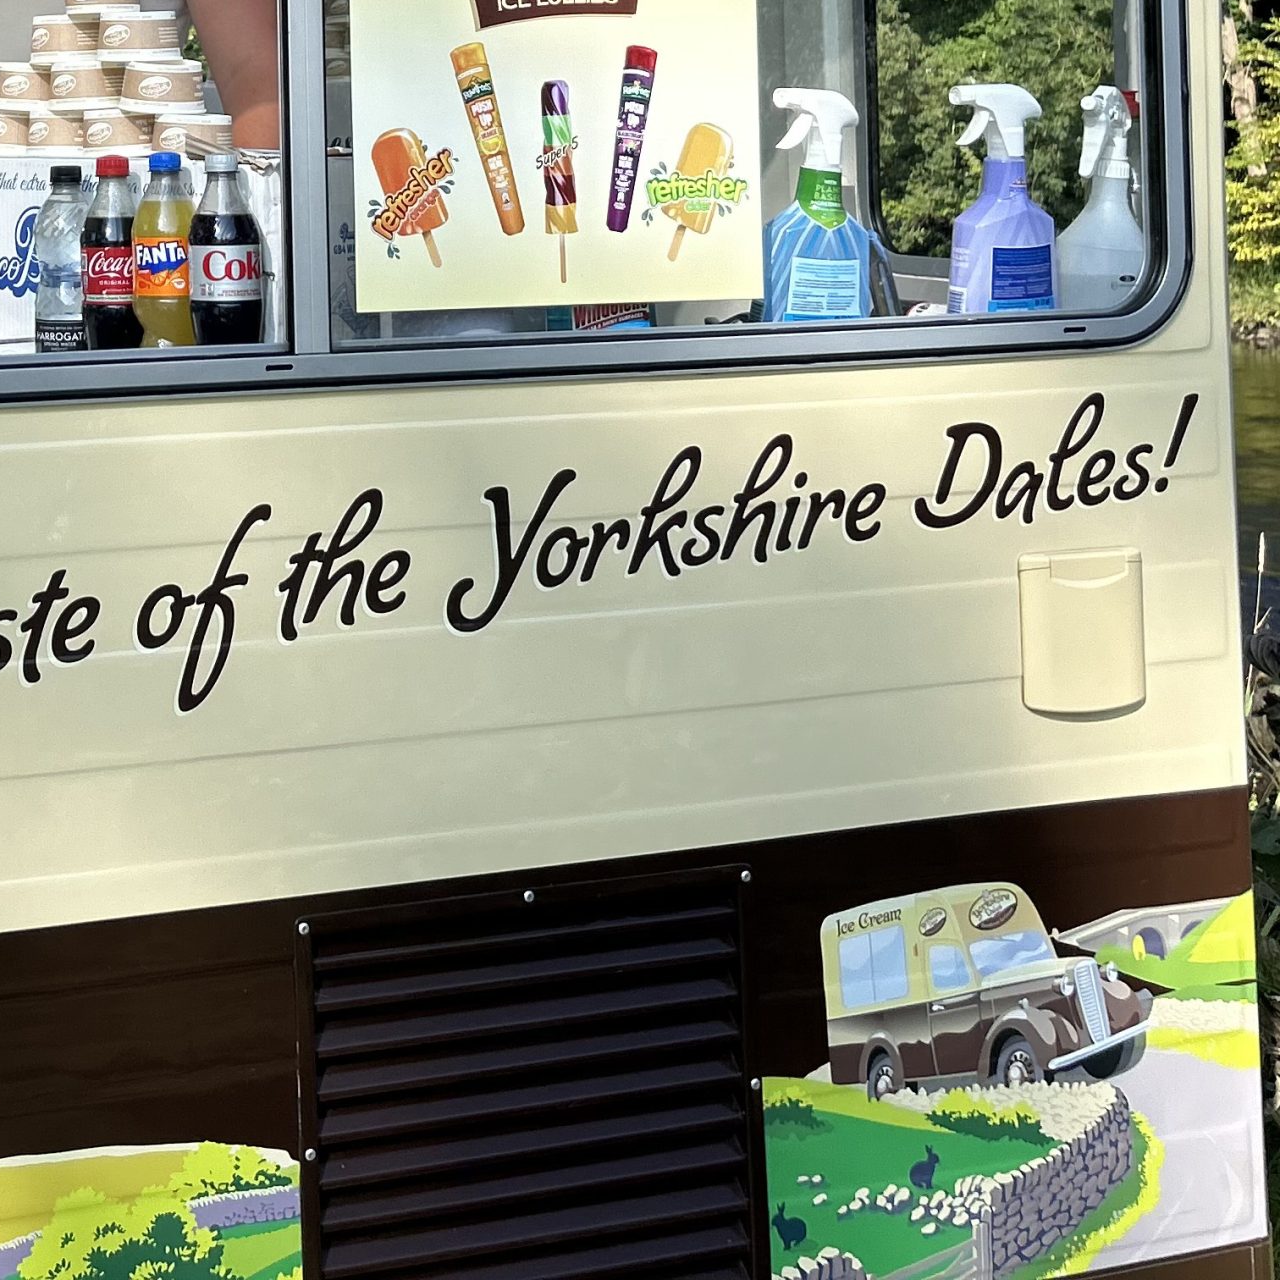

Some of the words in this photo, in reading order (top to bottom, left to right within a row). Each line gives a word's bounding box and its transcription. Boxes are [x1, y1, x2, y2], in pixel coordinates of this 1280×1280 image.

[535, 144, 567, 170] Super
[371, 148, 454, 241] refresher
[645, 169, 748, 207] refresher
[135, 241, 187, 266] FANTA
[202, 250, 261, 281] Cok
[135, 503, 270, 713] of
[277, 488, 411, 642] the
[446, 433, 888, 634] Yorkshire
[914, 392, 1199, 529] Dales!
[836, 918, 855, 937] Ice
[858, 908, 902, 929] Cream
